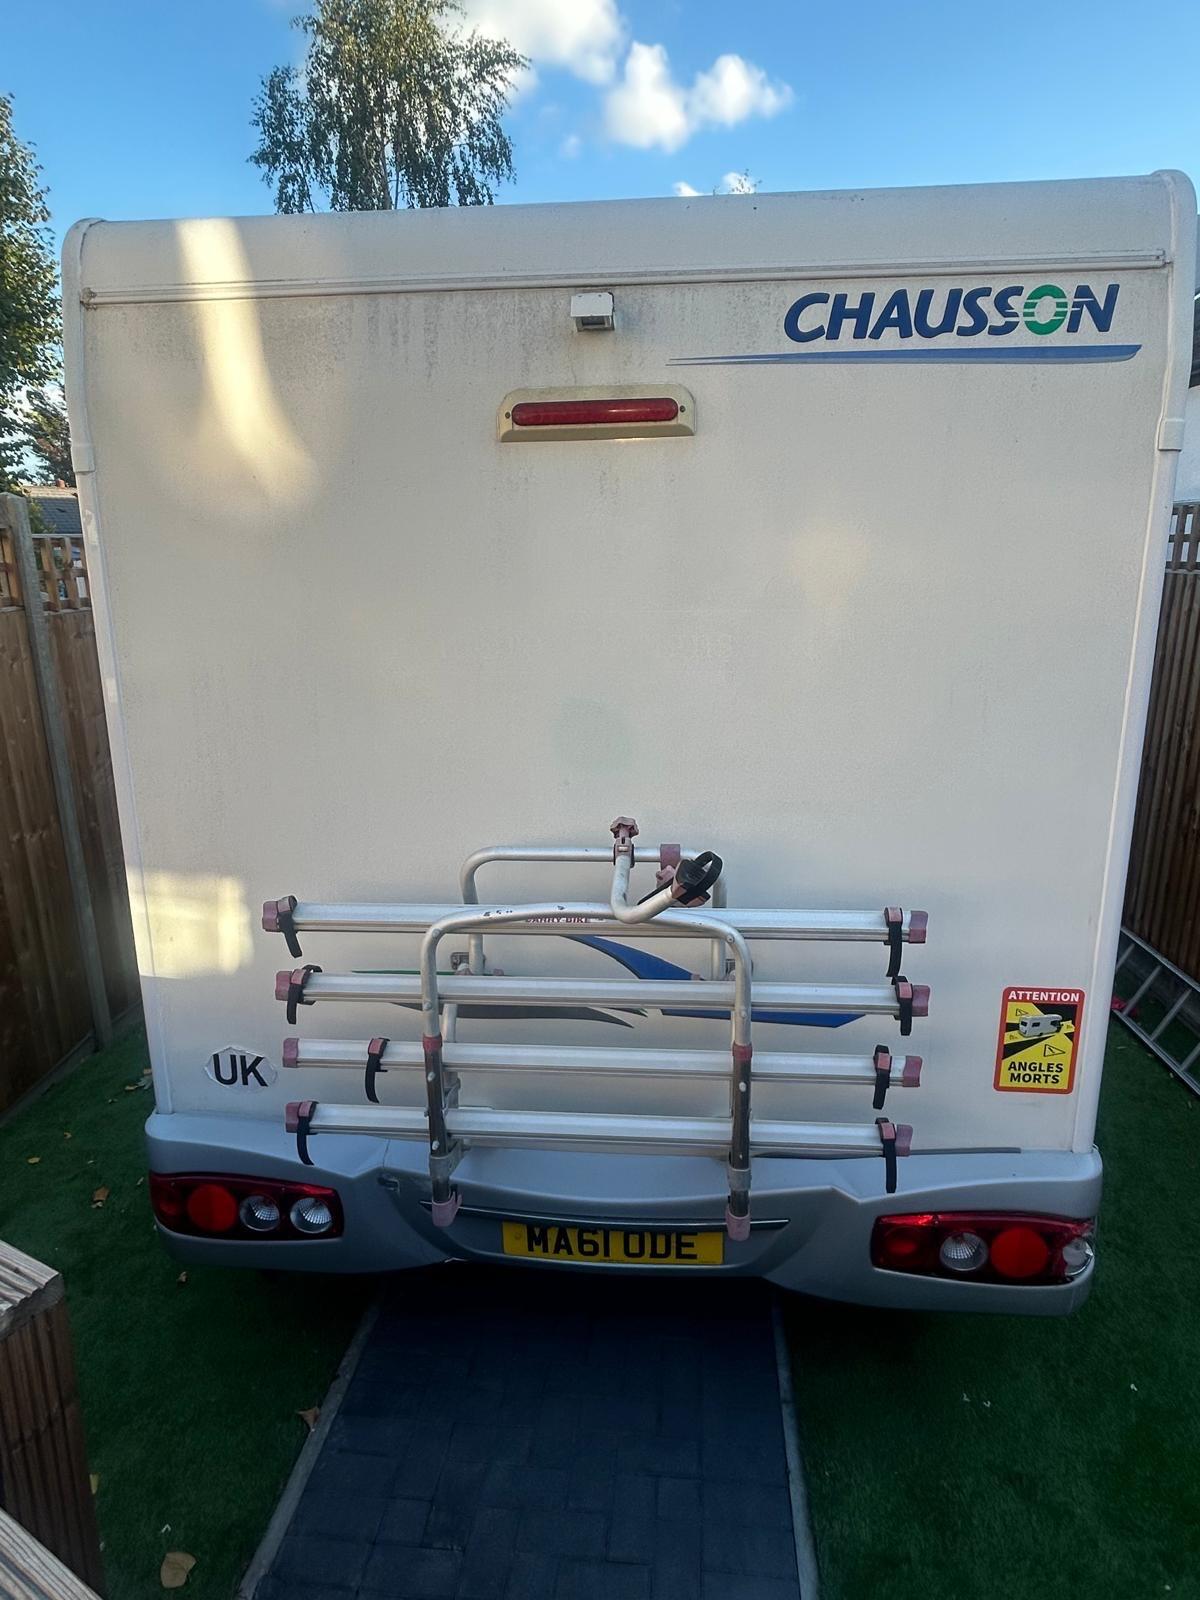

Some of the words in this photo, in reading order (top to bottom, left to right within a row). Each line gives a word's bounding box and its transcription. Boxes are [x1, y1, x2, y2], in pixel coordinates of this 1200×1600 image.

[784, 284, 1120, 343] CHAUSSON
[1008, 990, 1079, 1002] ATTENTION
[212, 1053, 269, 1087] UK
[1008, 1061, 1063, 1073] ANGLES
[1009, 1073, 1059, 1084] MORTS
[526, 1226, 611, 1258] MA61
[623, 1230, 698, 1259] ODE
